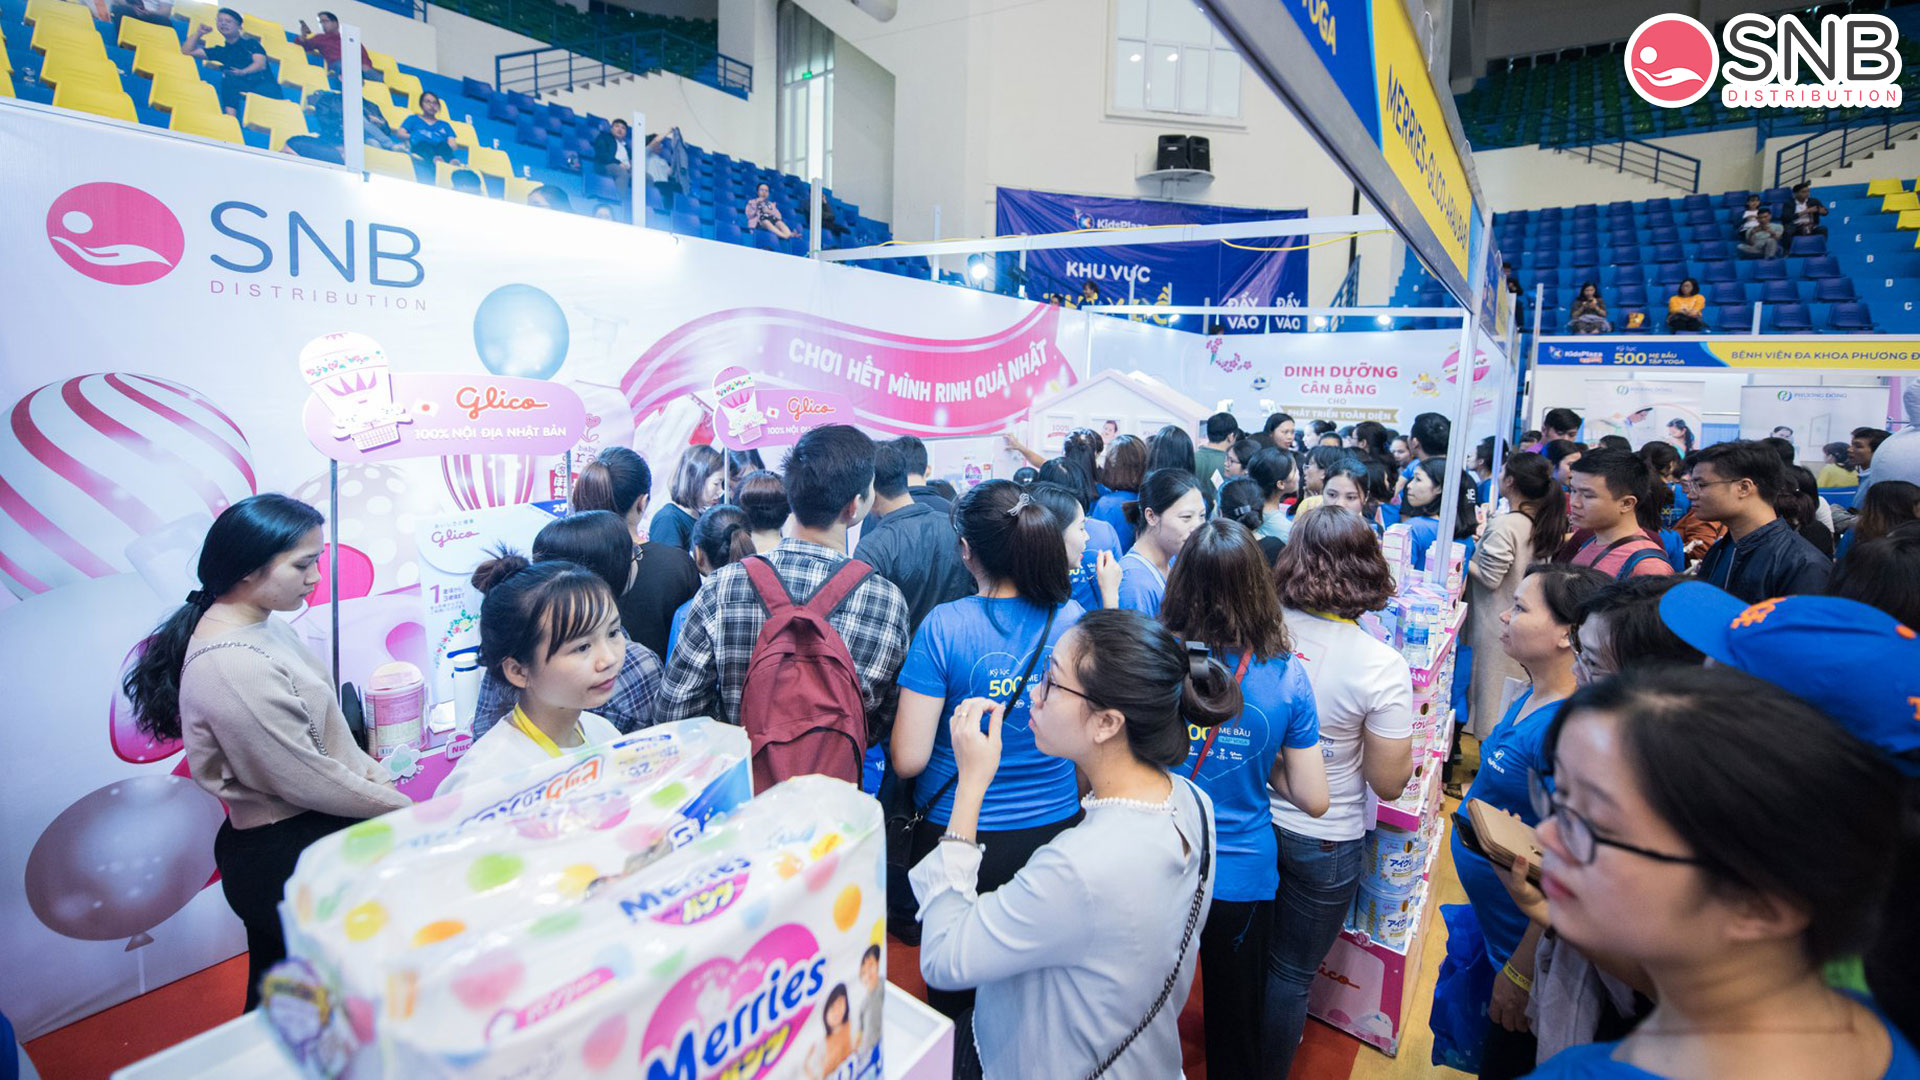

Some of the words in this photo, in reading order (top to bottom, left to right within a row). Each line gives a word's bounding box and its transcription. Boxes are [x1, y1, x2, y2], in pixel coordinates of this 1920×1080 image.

[1302, 0, 1336, 55] OGA
[210, 201, 425, 288] SNB
[1855, 234, 1862, 242] E
[1066, 261, 1107, 280] KHU
[210, 280, 427, 311] DISTRIBUTION
[1614, 352, 1647, 364] 500
[1731, 350, 1763, 360] BỆNH
[1794, 352, 1811, 360] ĐA
[1814, 352, 1849, 360] KHOA
[1852, 351, 1908, 360] PHƯƠNG
[789, 338, 843, 377] CHƠI
[846, 354, 885, 391] HẾT
[888, 372, 931, 403] MÌNH
[935, 379, 972, 403] RINH
[1008, 338, 1047, 384] NHẬT
[1284, 366, 1325, 378] DINH
[1330, 362, 1398, 378] DƯỠNG
[1301, 381, 1330, 394] CÂN
[1334, 379, 1377, 395] BẰNG
[455, 386, 549, 420] Glico
[787, 397, 836, 421] Glico
[414, 427, 450, 440] 100%
[452, 425, 477, 441] NỘI
[481, 427, 503, 441] ĐỊA
[507, 425, 540, 440] NHẬT
[543, 424, 567, 437] BẢN
[431, 529, 480, 548] Glico
[647, 957, 827, 1080] Merries
